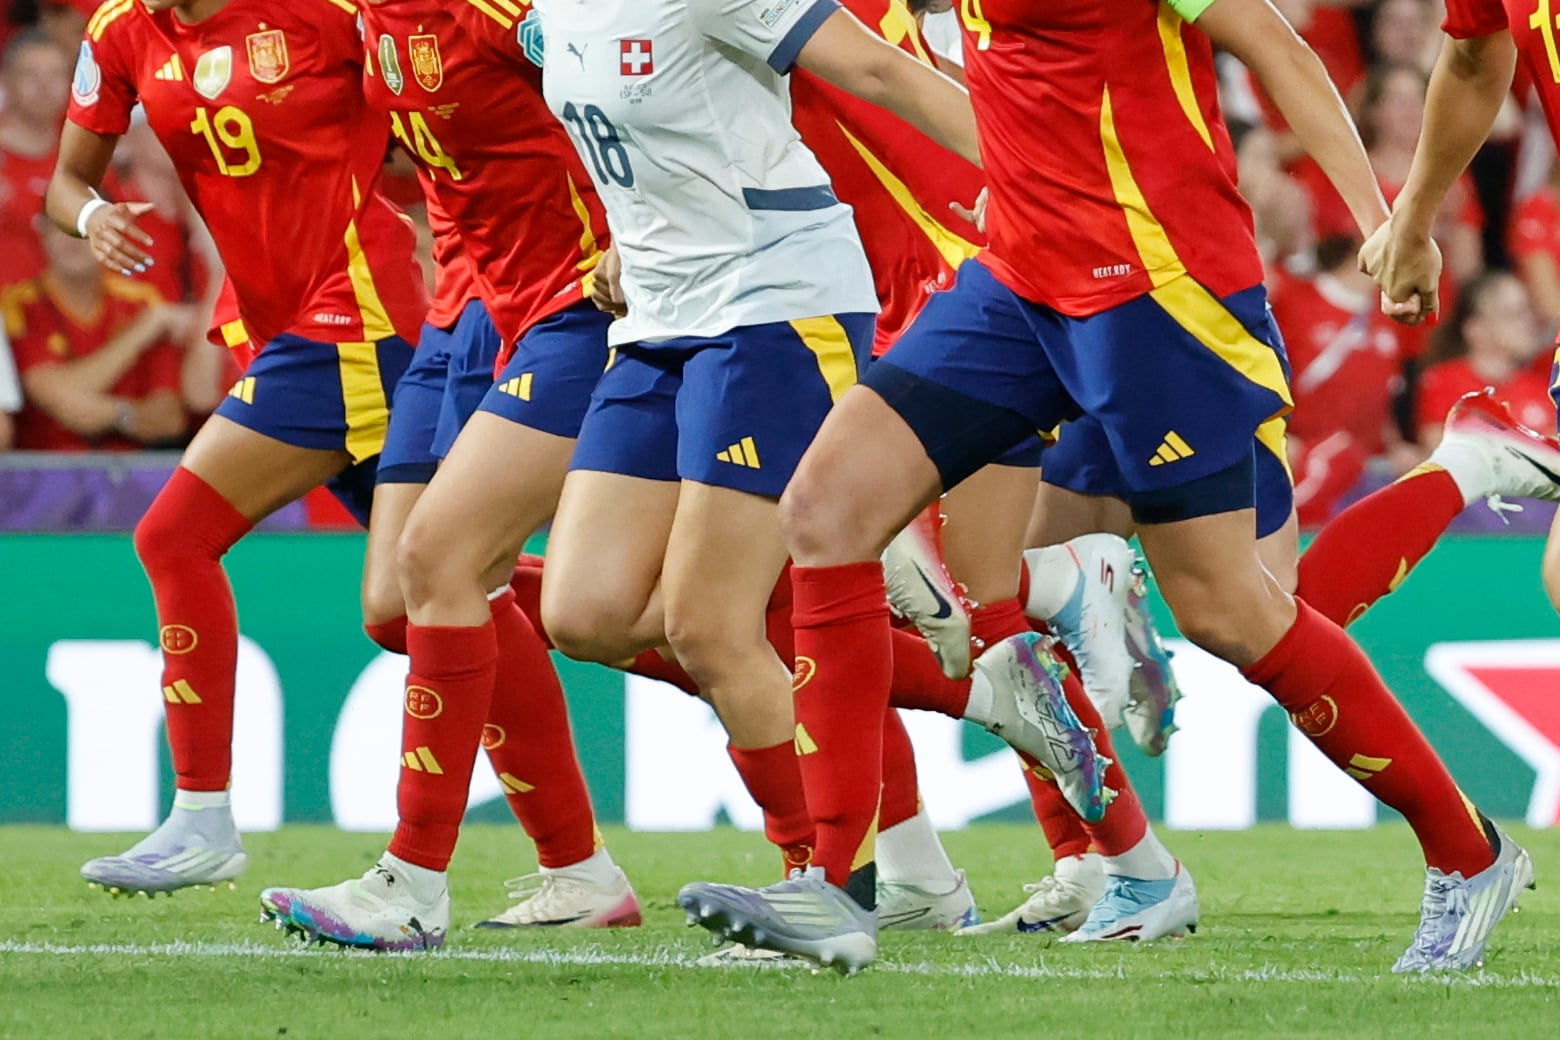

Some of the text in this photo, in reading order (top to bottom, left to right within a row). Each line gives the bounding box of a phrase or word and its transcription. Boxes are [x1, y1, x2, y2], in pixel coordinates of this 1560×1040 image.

[190, 105, 262, 177] 19
[389, 110, 464, 181] 14
[563, 101, 635, 188] 18
[1092, 263, 1131, 279] HEAT.RDY
